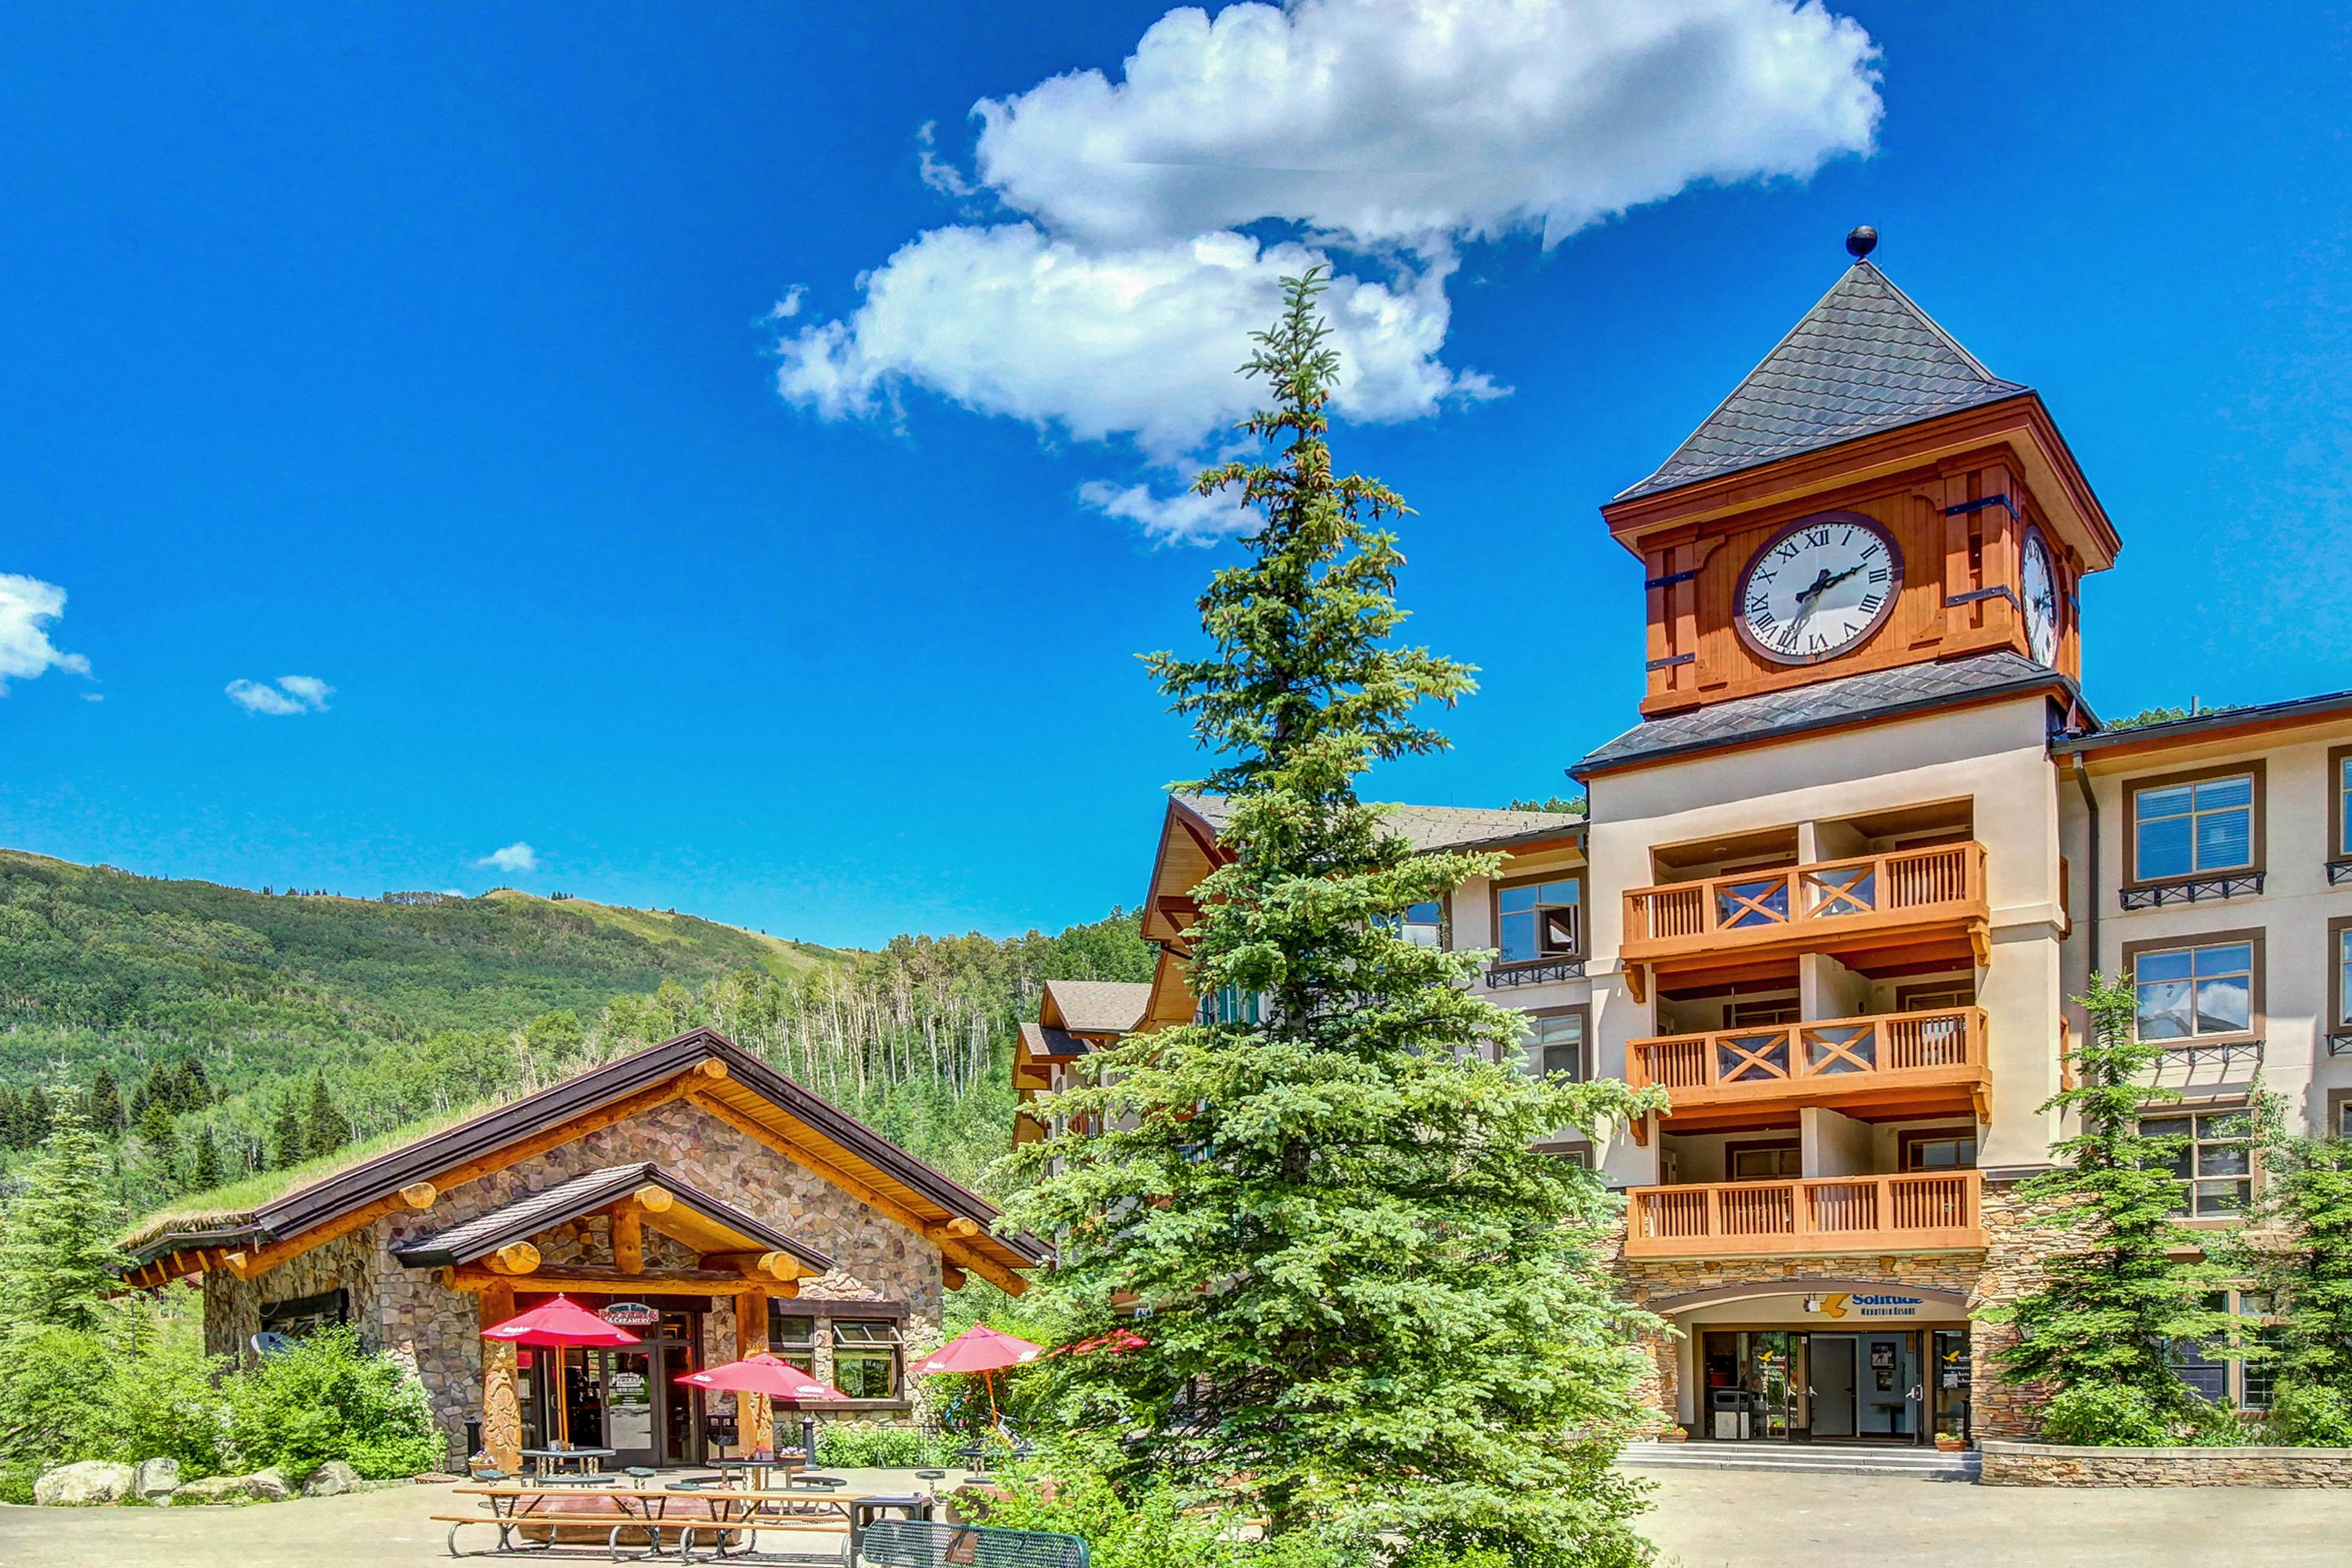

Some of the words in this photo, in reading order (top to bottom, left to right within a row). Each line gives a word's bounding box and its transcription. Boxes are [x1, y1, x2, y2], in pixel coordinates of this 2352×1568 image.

[1804, 529, 1830, 549] XII
[1841, 530, 1854, 546] I
[1776, 541, 1800, 564] XI
[1860, 544, 1880, 560] II
[1757, 568, 1778, 584] X
[1868, 567, 1888, 584] III
[1751, 592, 1769, 612] IX
[1858, 593, 1882, 614] IIII
[1755, 612, 1780, 640] VIII
[1842, 622, 1860, 638] V
[1808, 633, 1829, 650] VI
